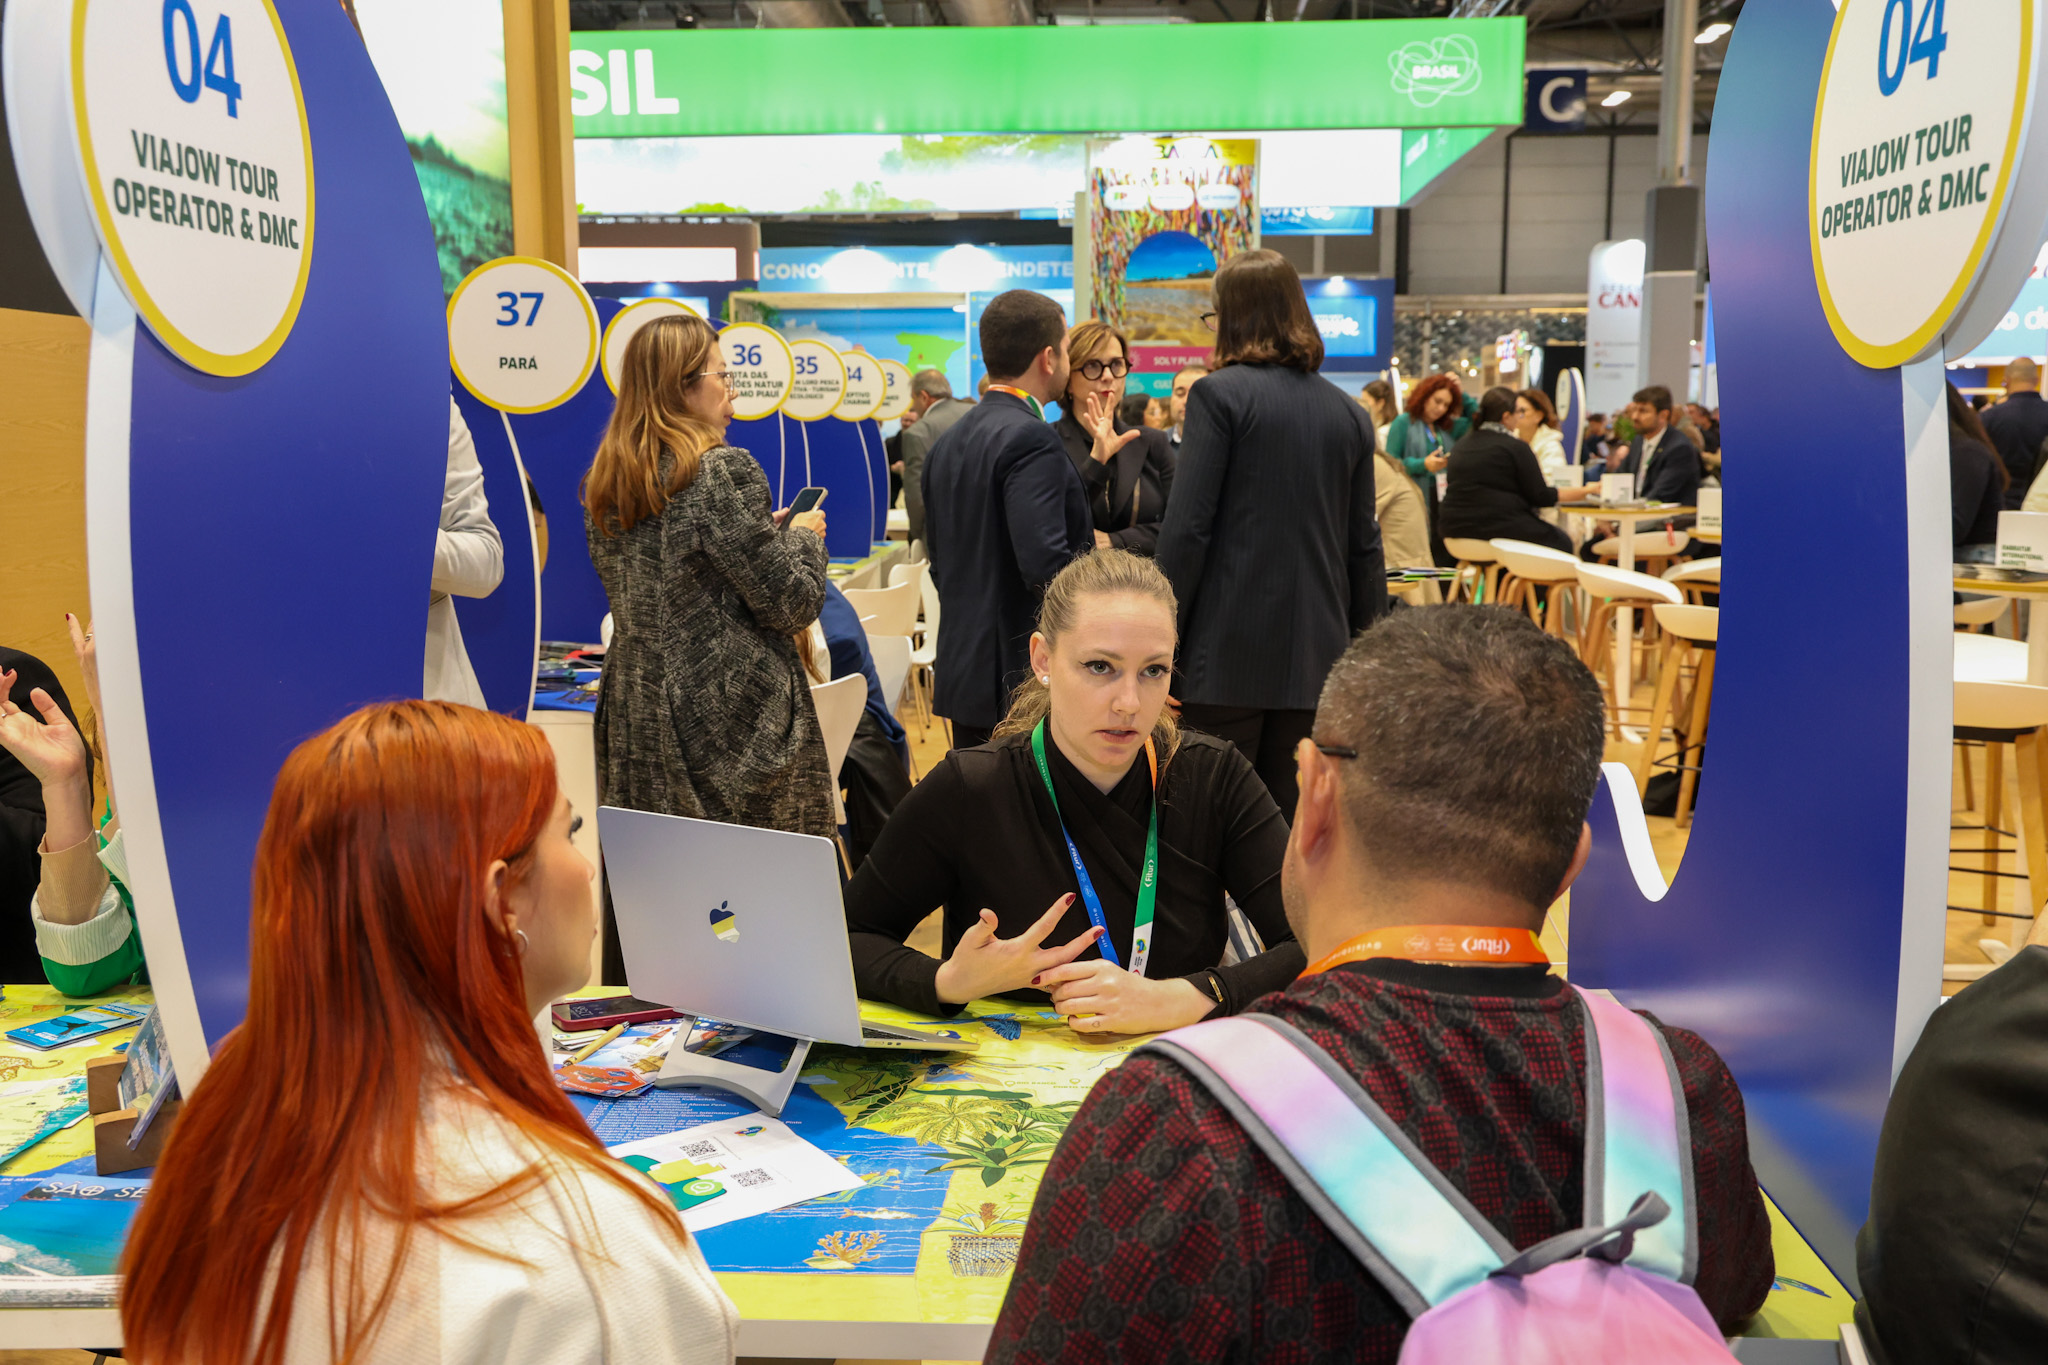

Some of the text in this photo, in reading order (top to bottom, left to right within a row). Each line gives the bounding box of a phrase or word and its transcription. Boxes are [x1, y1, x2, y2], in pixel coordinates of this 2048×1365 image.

[162, 0, 242, 119] 04
[1878, 0, 1948, 97] 04
[569, 49, 679, 117] SIL
[1412, 65, 1461, 79] BRASIL
[1539, 77, 1581, 123] C
[131, 129, 280, 202] VIAJOW TOUR
[1841, 113, 1973, 188] VIAJOW TOUR
[113, 177, 299, 250] OPERATOR & DMC
[1821, 163, 1990, 239] OPERATOR & DMC
[496, 291, 544, 326] 37
[499, 355, 538, 370] PARÁ
[732, 344, 762, 366] 36
[794, 356, 818, 374] 35
[735, 380, 751, 388] ÕES
[750, 371, 768, 379] DAS
[886, 372, 895, 387] 3
[114, 1187, 150, 1198] SE
